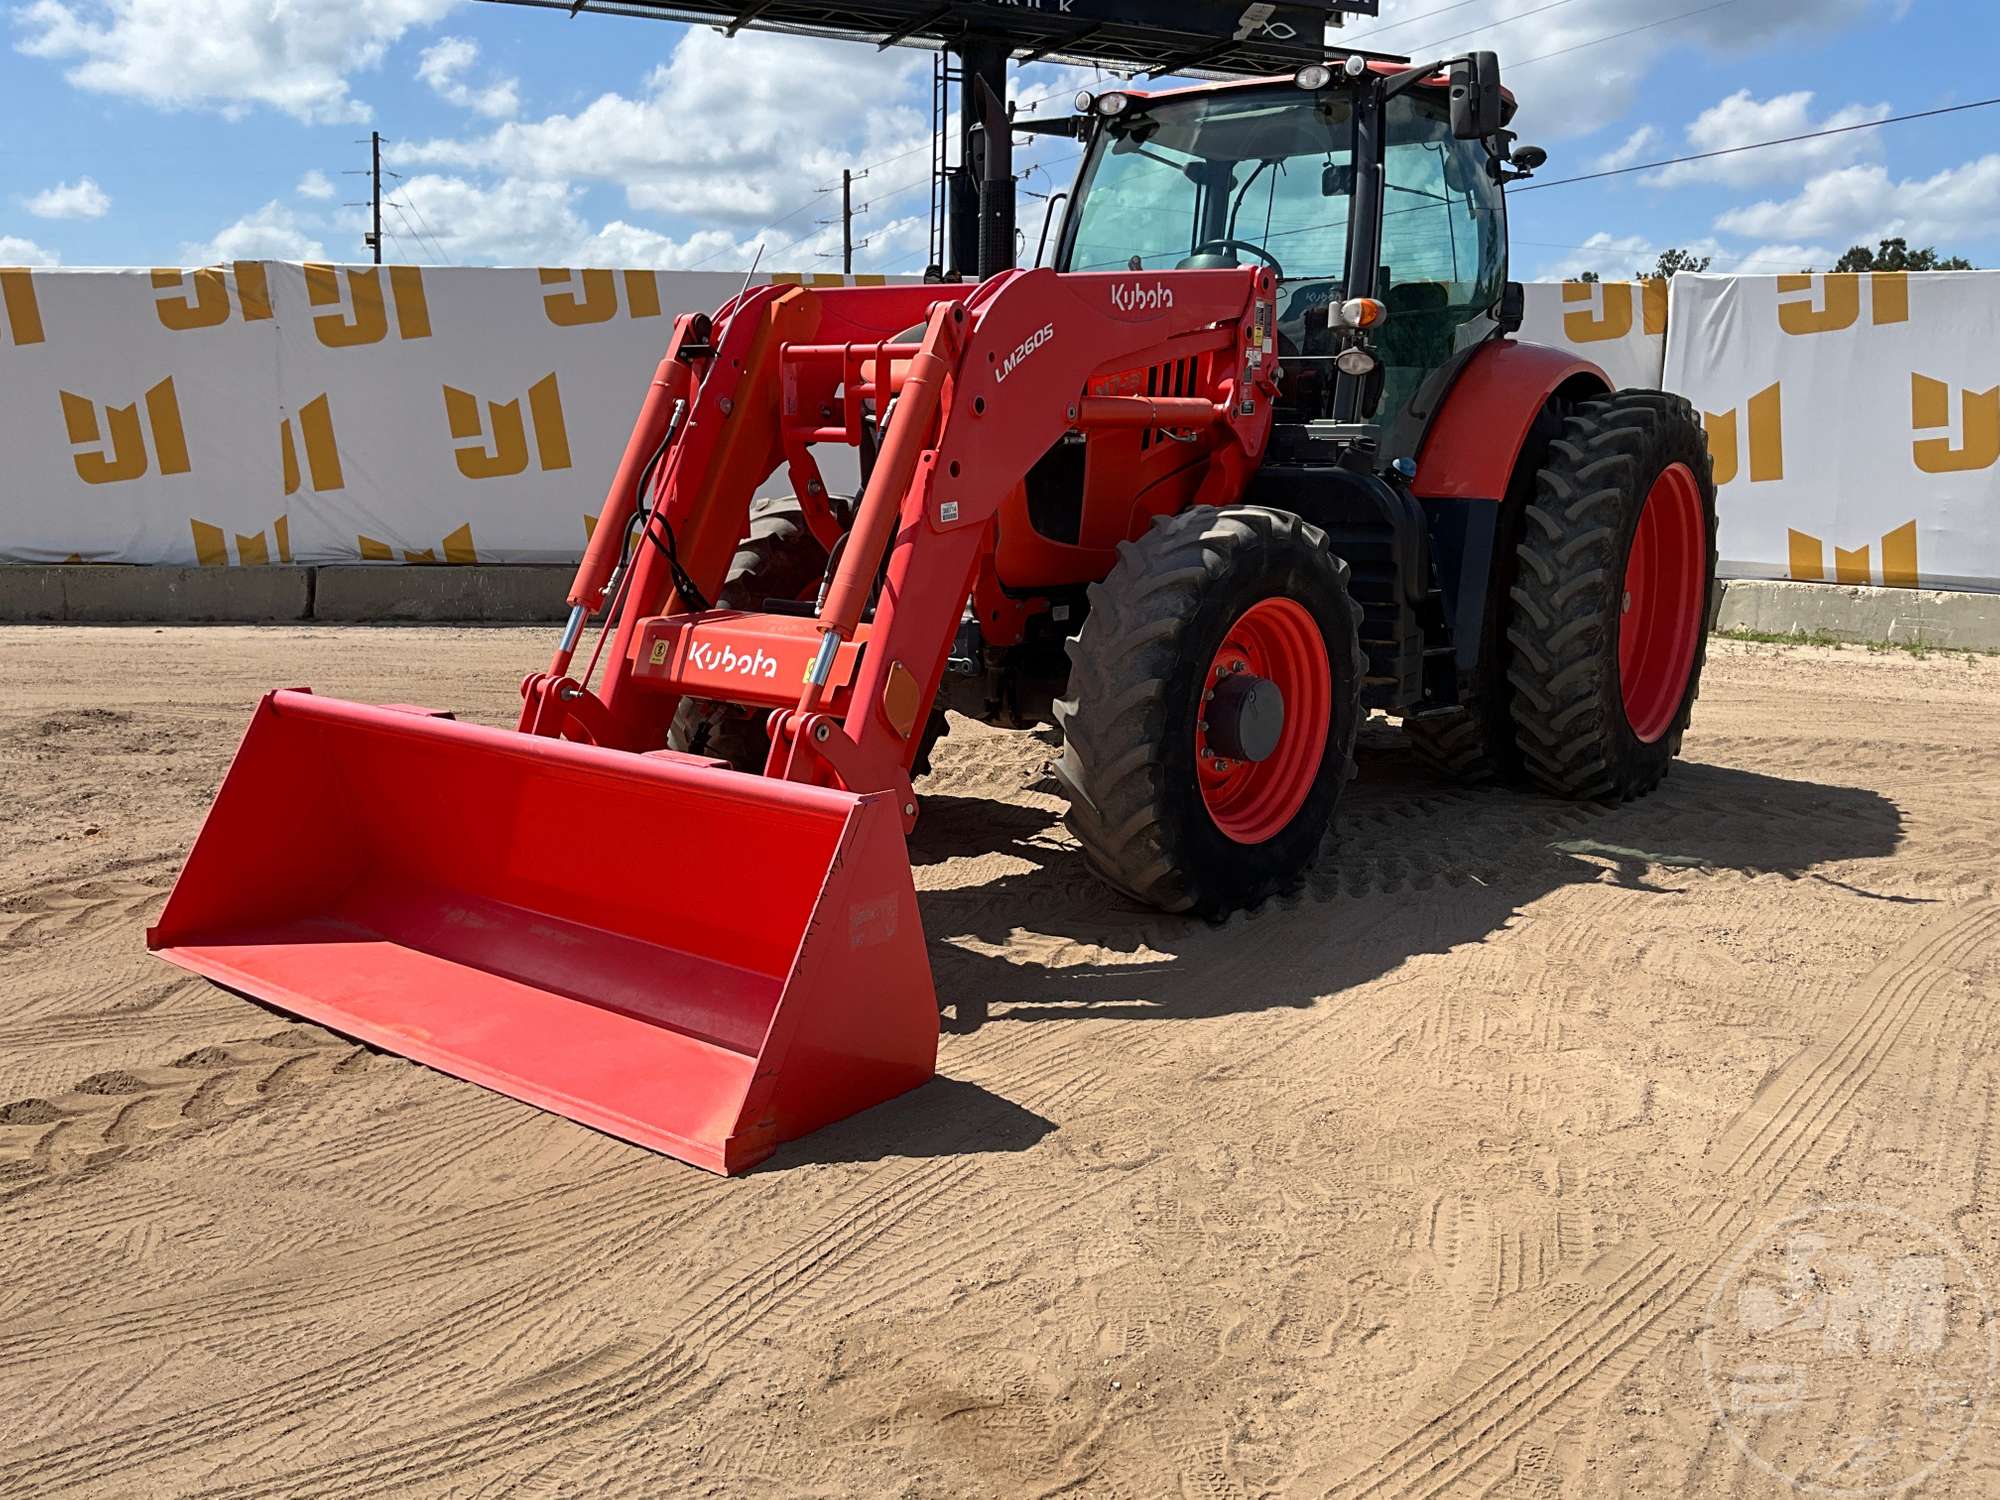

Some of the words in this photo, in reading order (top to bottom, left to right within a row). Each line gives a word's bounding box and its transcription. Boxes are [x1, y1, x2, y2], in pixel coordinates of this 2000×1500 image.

[1111, 281, 1173, 311] Kubota
[995, 322, 1053, 384] LM2605
[688, 640, 777, 679] Kubota
